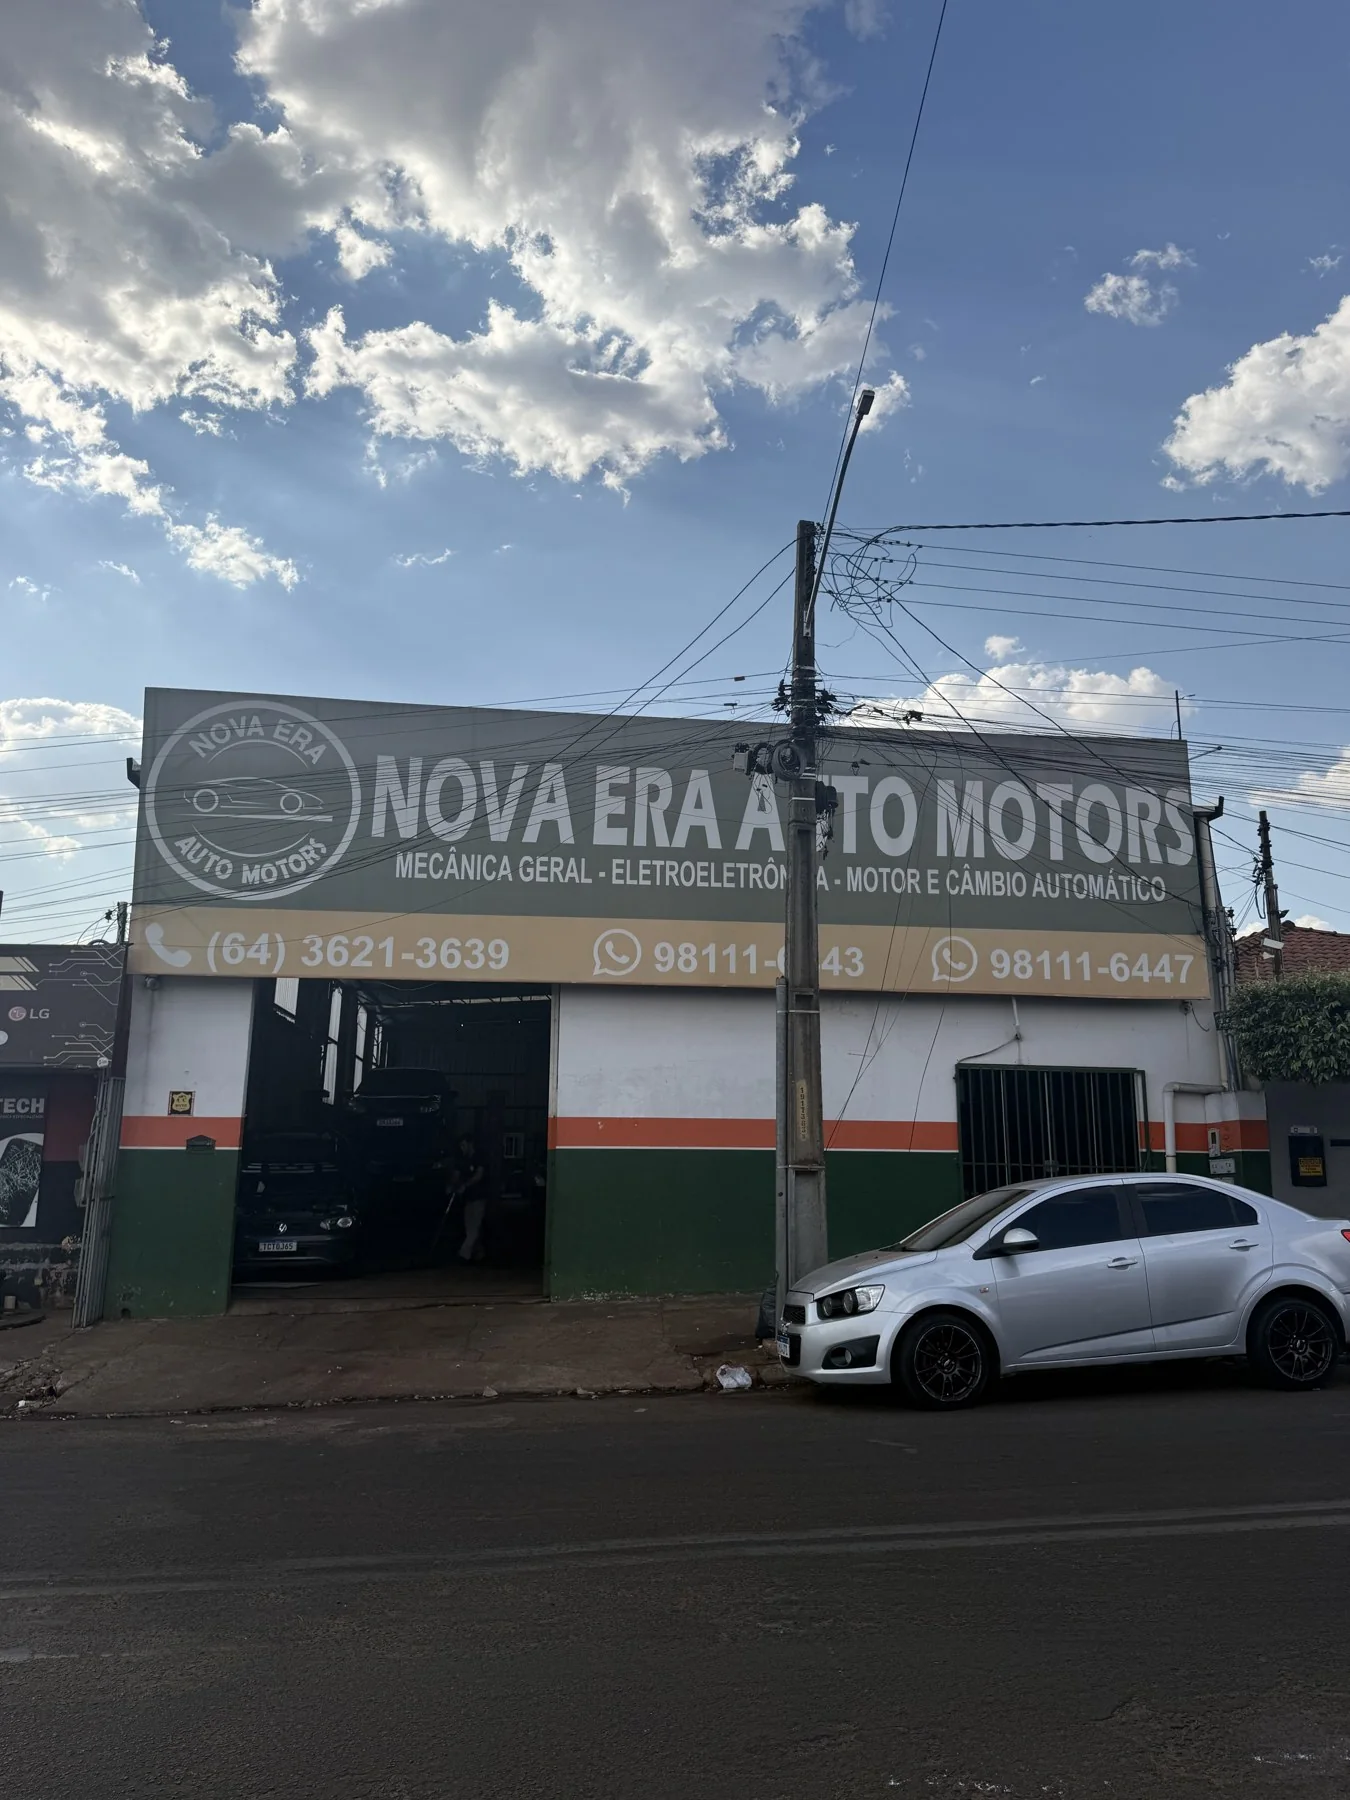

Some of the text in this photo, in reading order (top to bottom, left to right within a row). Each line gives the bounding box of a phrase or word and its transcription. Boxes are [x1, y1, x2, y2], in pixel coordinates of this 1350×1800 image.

[189, 715, 327, 764] NOVA ERA
[371, 755, 1194, 866] NOVA ERA ATO MOTORS
[174, 836, 327, 885] AUTO MOTORS
[395, 846, 512, 882] MECÂNICA
[519, 855, 592, 884] GERAL
[611, 857, 829, 892] ELETROELETRÔNA
[846, 866, 920, 894] MOTOR
[927, 869, 939, 895] E
[946, 864, 1027, 898] CÂMBIO
[1032, 868, 1166, 902] AUTOMÁTICO
[207, 931, 510, 973] (64) 3621-3639
[653, 942, 865, 977] 98111-43
[990, 948, 1195, 984] 98111-6447
[0, 1097, 45, 1114] ECH
